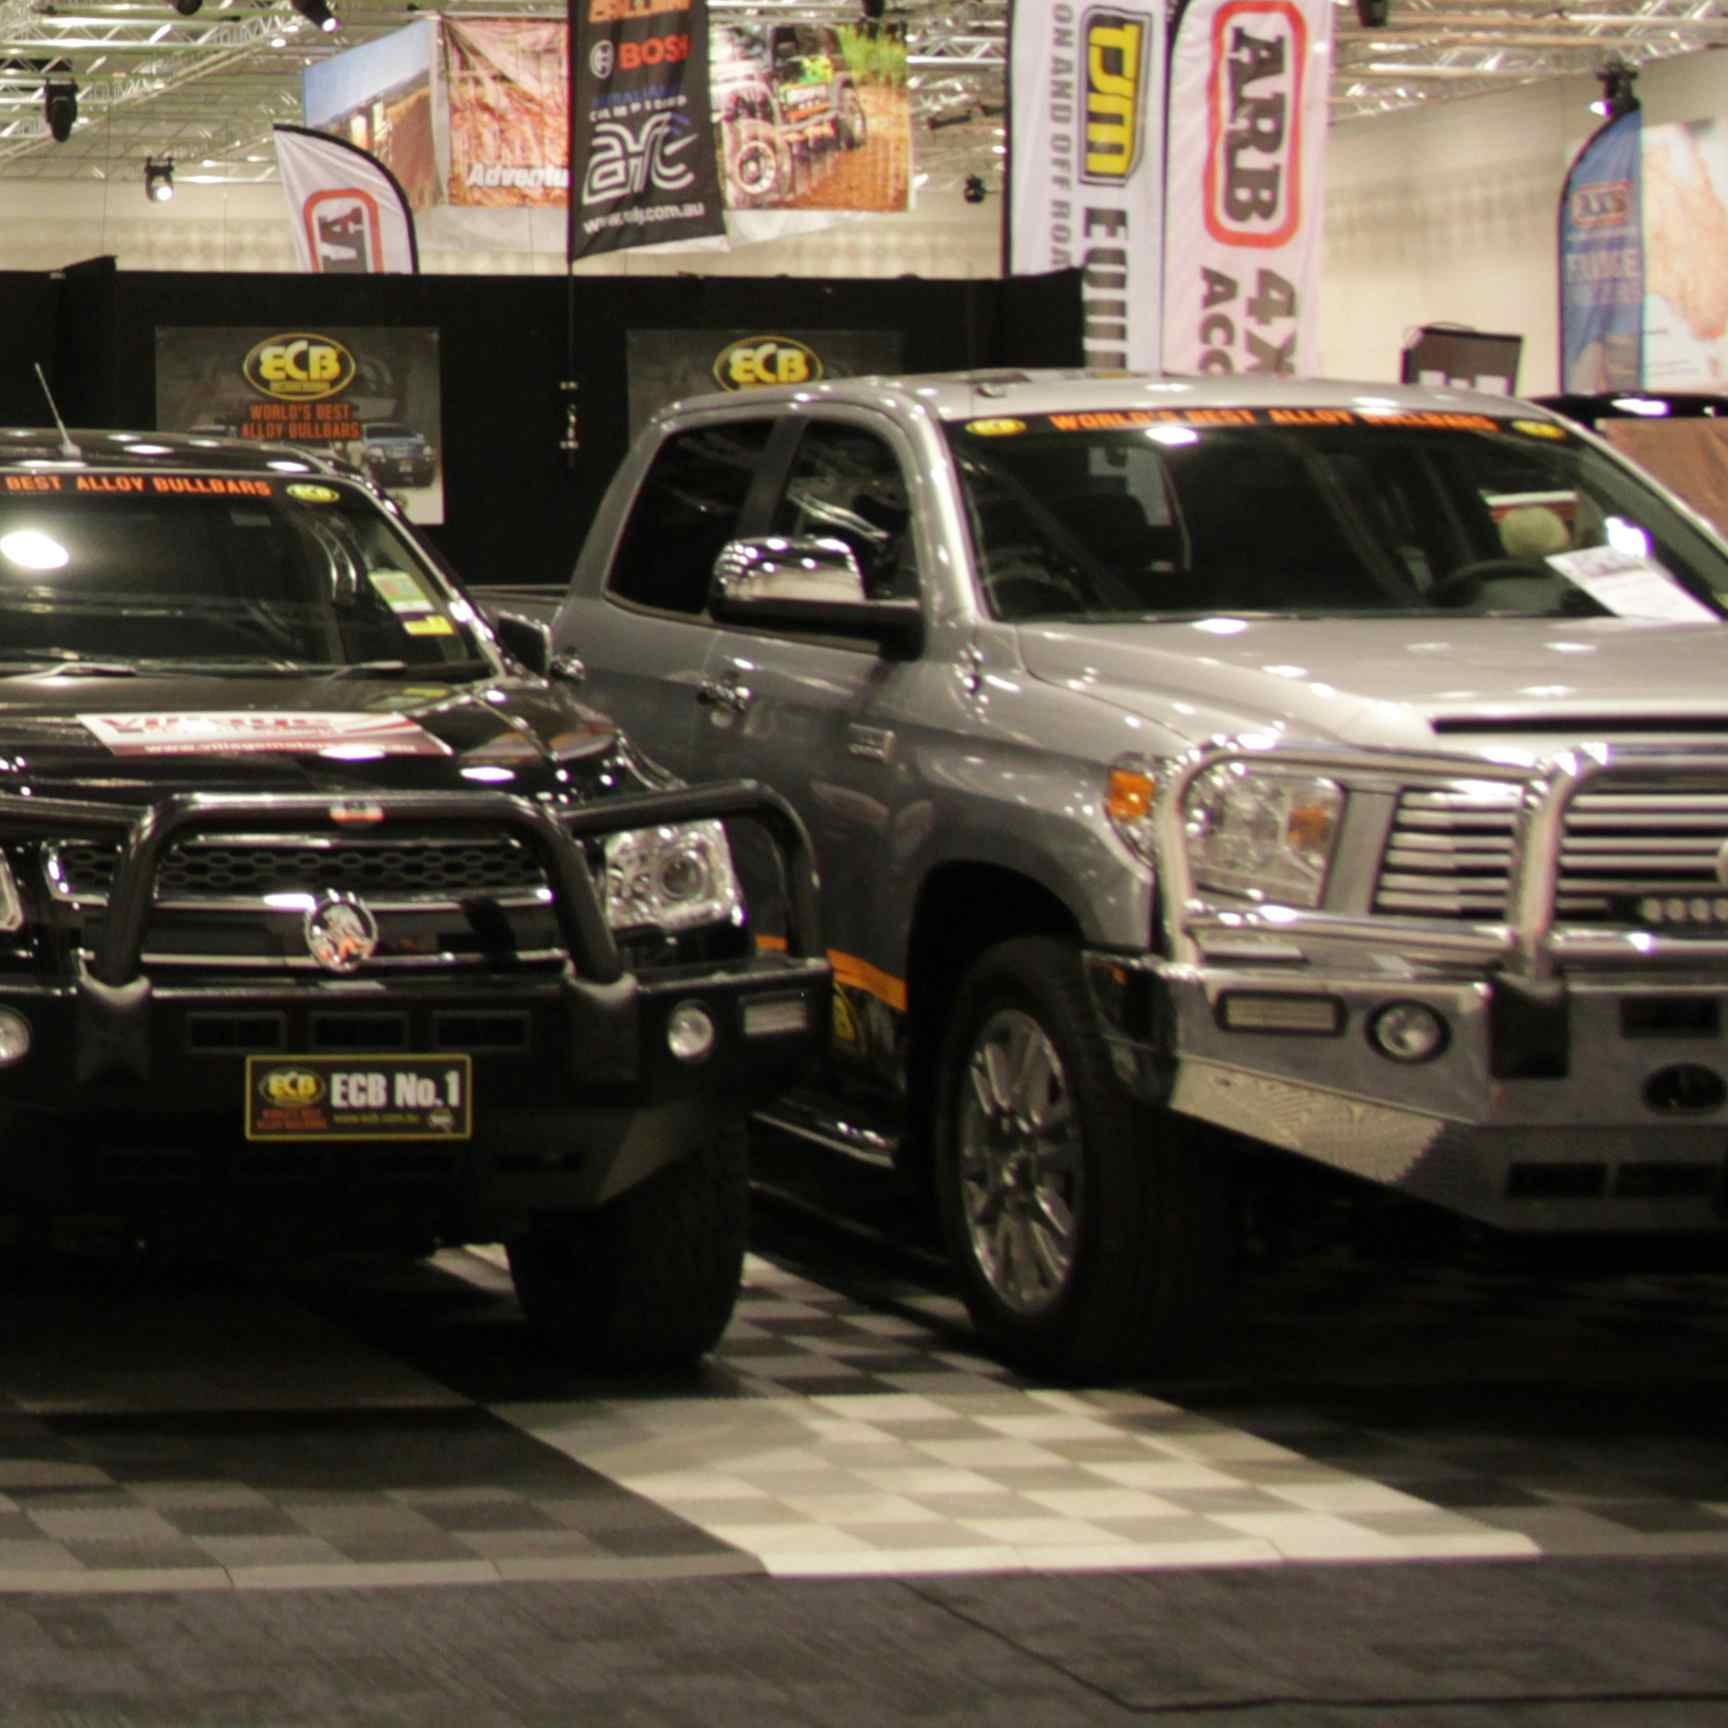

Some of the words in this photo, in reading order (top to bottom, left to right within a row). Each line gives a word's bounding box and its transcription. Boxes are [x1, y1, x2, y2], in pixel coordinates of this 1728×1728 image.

[619, 35, 689, 69] BOS
[1223, 26, 1287, 223] ARB
[260, 339, 342, 381] ECB
[729, 341, 810, 385] ECB
[250, 404, 311, 419] WORLD'S
[316, 404, 351, 419] BEST
[1048, 411, 1178, 430] WORLD'S
[1183, 408, 1256, 424] BEST
[1267, 409, 1355, 426] ALLOY
[288, 423, 360, 439] BULLBARS
[5, 476, 63, 491] BEST
[75, 477, 145, 492] ALLOY
[154, 478, 272, 497] BULLBARS
[330, 1072, 387, 1107] ECB
